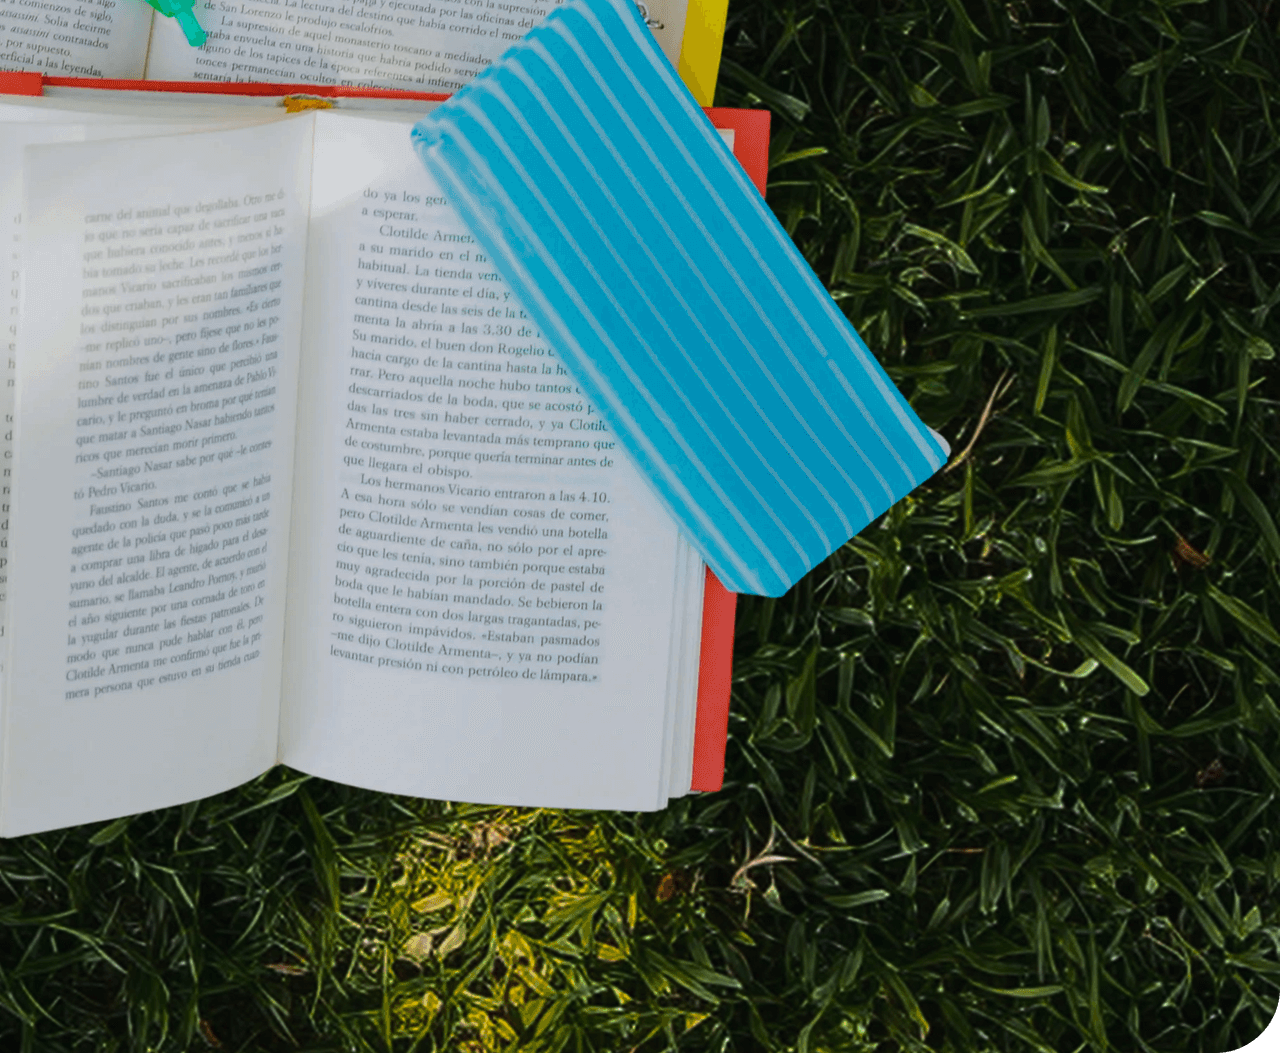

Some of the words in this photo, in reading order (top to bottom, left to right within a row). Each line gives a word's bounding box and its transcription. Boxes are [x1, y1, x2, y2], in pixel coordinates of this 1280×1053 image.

[361, 207, 368, 216] a
[372, 208, 418, 221] esperar.
[74, 452, 100, 464] ricos
[102, 449, 123, 463] que
[125, 442, 170, 458] merecían
[172, 436, 199, 451] morir
[200, 431, 237, 449] primero.
[343, 455, 364, 467] que
[367, 456, 408, 472] llegara
[412, 462, 423, 474] el
[427, 463, 473, 480] obispo.
[87, 484, 118, 499] Pedro
[119, 479, 157, 494] Vicario.
[360, 472, 381, 487] Los
[384, 476, 445, 494] hermanos
[447, 483, 491, 498] Vicario
[493, 489, 545, 501] entraron
[548, 492, 556, 501] a
[559, 489, 576, 502] las
[578, 491, 610, 503] 4.10.
[340, 487, 350, 500] A
[354, 493, 372, 503] esa
[377, 493, 405, 508] hora
[410, 498, 437, 511] sólo
[442, 504, 455, 513] se
[460, 503, 508, 517] vendían
[512, 508, 546, 519] cosas
[550, 507, 565, 520] de
[569, 511, 609, 523] comer,
[339, 508, 365, 520] pero
[368, 510, 417, 527] Clotilde
[419, 517, 473, 532] Armenta
[477, 521, 494, 534] les
[497, 524, 538, 536] vendió
[541, 528, 564, 538] una
[568, 526, 608, 540] botella
[329, 644, 374, 664] levantar
[377, 656, 422, 671] presión
[425, 661, 438, 672] ni
[441, 665, 464, 675] con
[467, 666, 519, 679] petróleo
[521, 667, 537, 680] de
